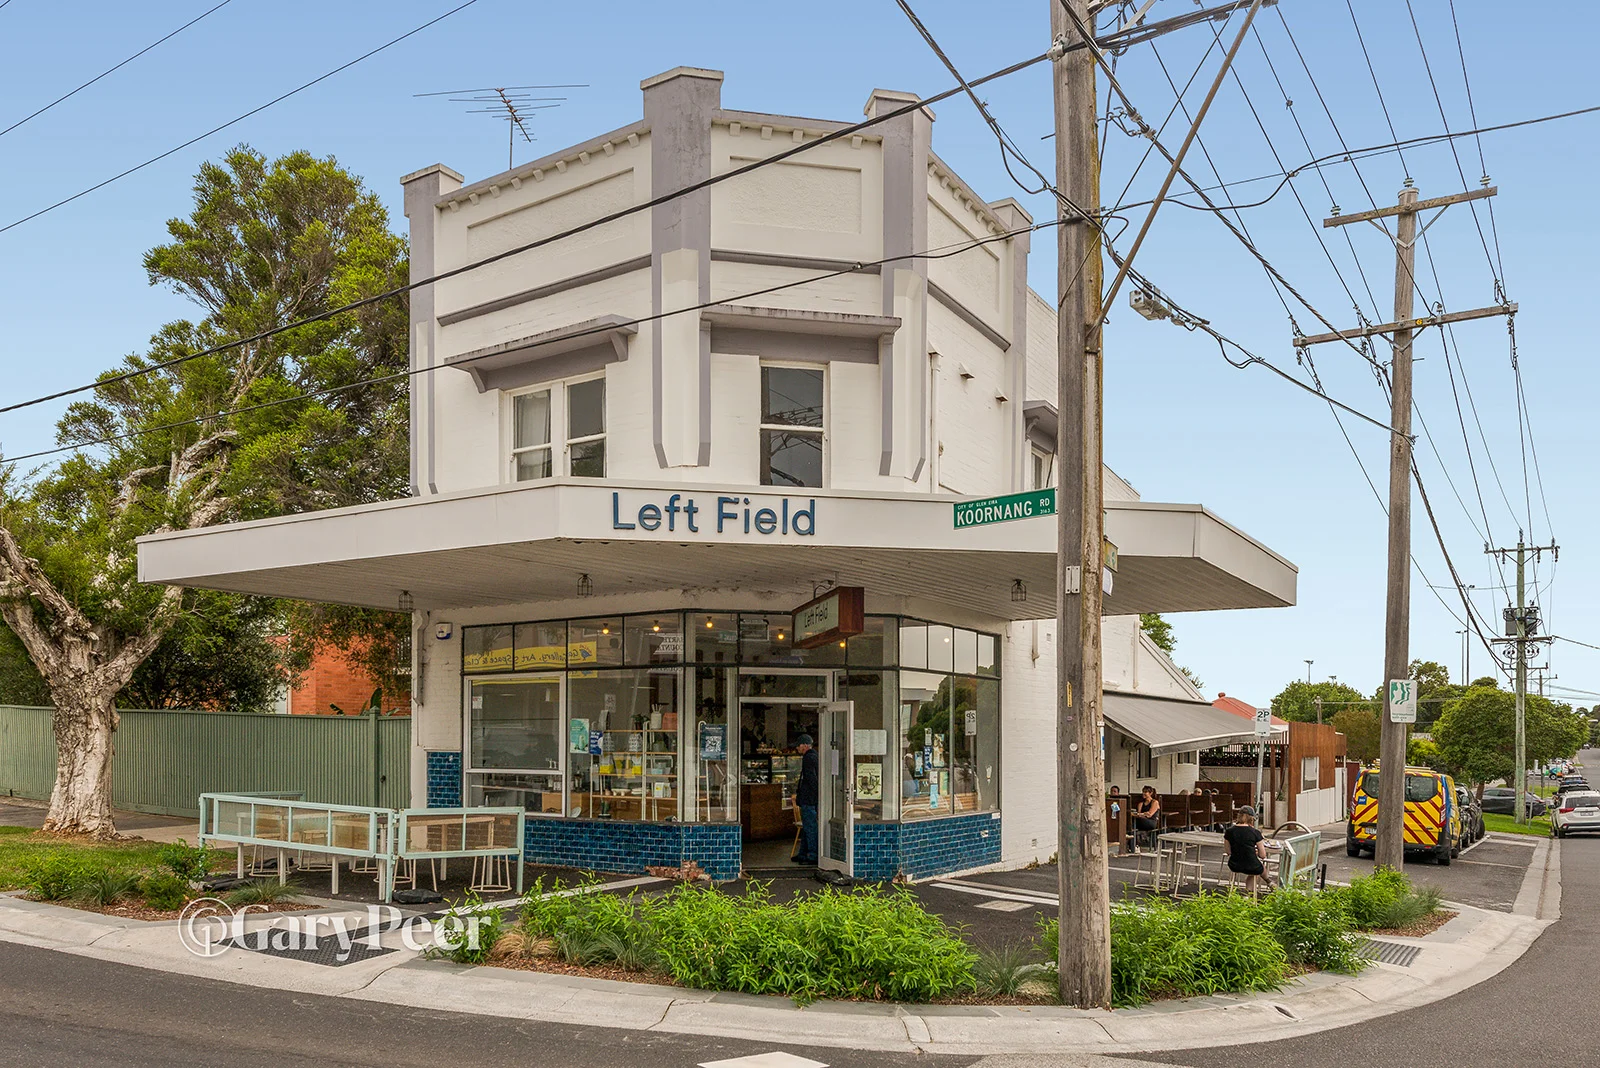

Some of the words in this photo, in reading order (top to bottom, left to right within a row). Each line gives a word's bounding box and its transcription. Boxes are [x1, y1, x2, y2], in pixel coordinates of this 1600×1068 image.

[612, 491, 699, 533] Left
[717, 496, 816, 536] Field
[957, 500, 1033, 526] KOORNANG
[1039, 498, 1051, 507] RD
[804, 609, 814, 628] Left
[815, 602, 828, 624] Field
[1257, 710, 1270, 718] 2P
